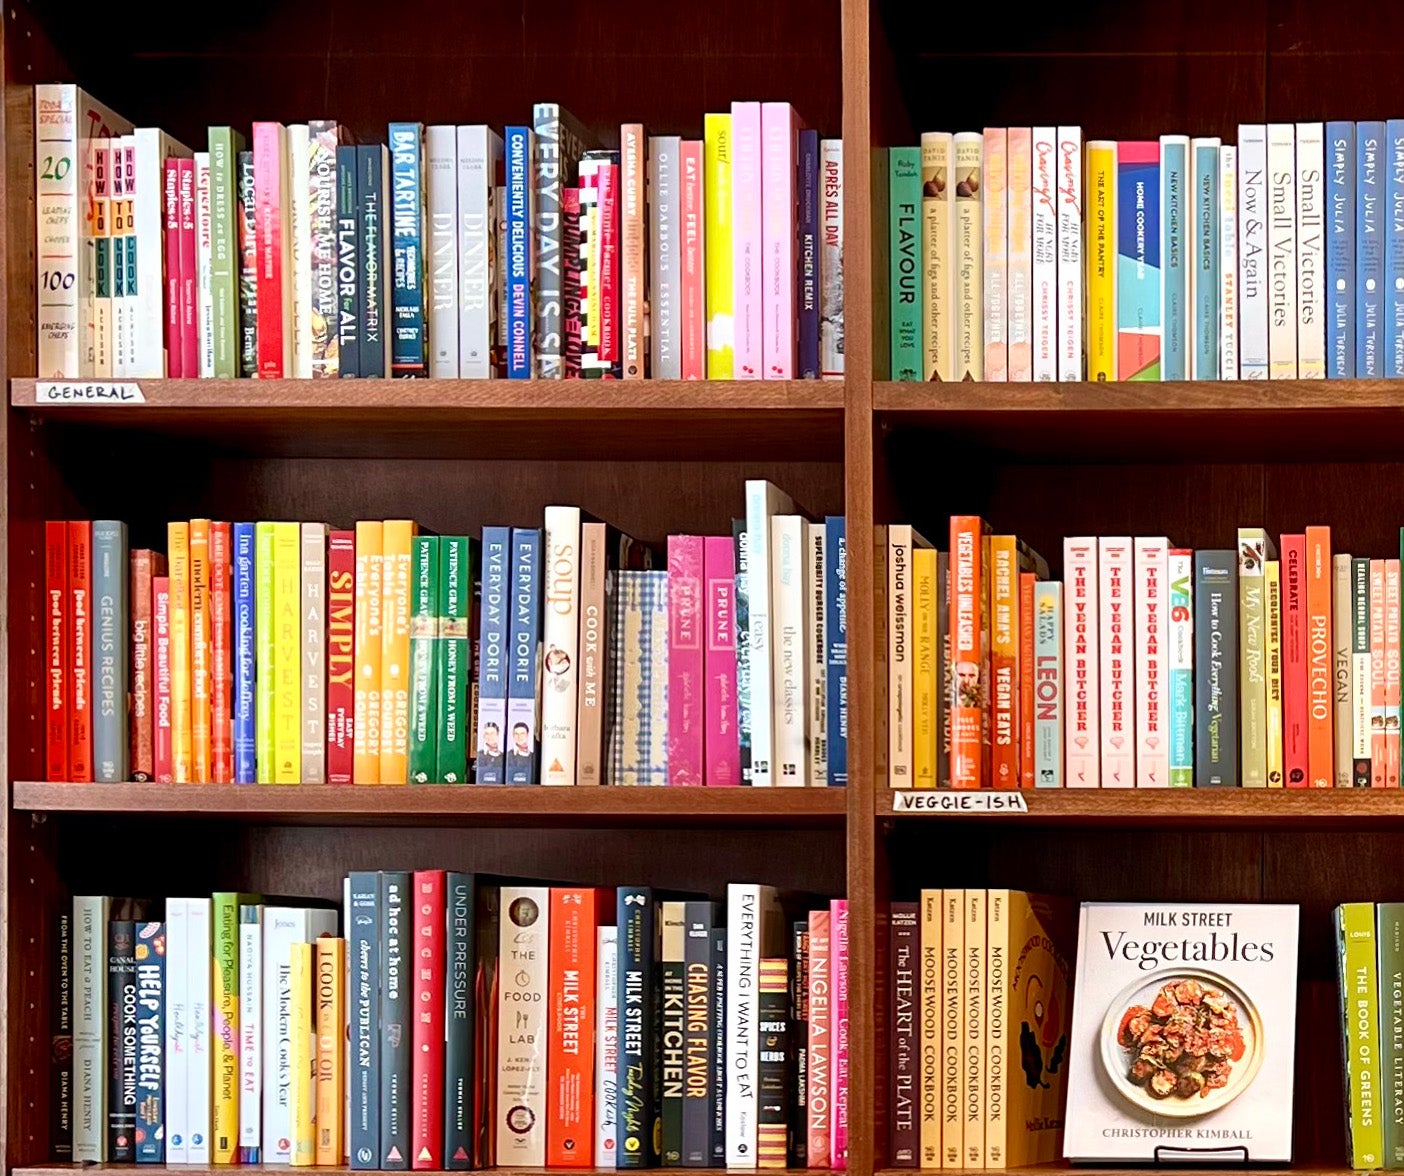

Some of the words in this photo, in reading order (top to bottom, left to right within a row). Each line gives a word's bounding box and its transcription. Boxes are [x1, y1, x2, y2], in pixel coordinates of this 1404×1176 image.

[1273, 172, 1291, 228] Small
[40, 272, 75, 290] 100
[900, 203, 914, 304] FLAVOUR
[1273, 234, 1291, 327] Victories
[48, 385, 134, 400] GENERAL
[517, 544, 530, 622] EVERYDAY
[1075, 567, 1086, 597] THE
[101, 595, 113, 652] GENIUS
[329, 570, 353, 689] SIMPLY
[1075, 603, 1087, 654] VEGAN
[516, 629, 529, 682] DORIE
[1312, 616, 1327, 720] PROVECHO
[101, 657, 113, 716] RECIPES
[1037, 656, 1057, 720] LEON
[1076, 660, 1087, 732] BUTCHER
[904, 796, 1021, 809] VEGGIE-ISH
[456, 885, 466, 938] UNDER
[1144, 913, 1177, 927] MILK
[1182, 913, 1232, 927] STREET
[1100, 930, 1274, 971] Vegetables
[454, 943, 466, 1019] PRESSURE
[688, 963, 707, 1030] CHASING
[687, 1035, 707, 1098] FLAVOR
[1103, 1128, 1193, 1139] CHRISTOPHER
[1197, 1129, 1253, 1139] KIMBALL
